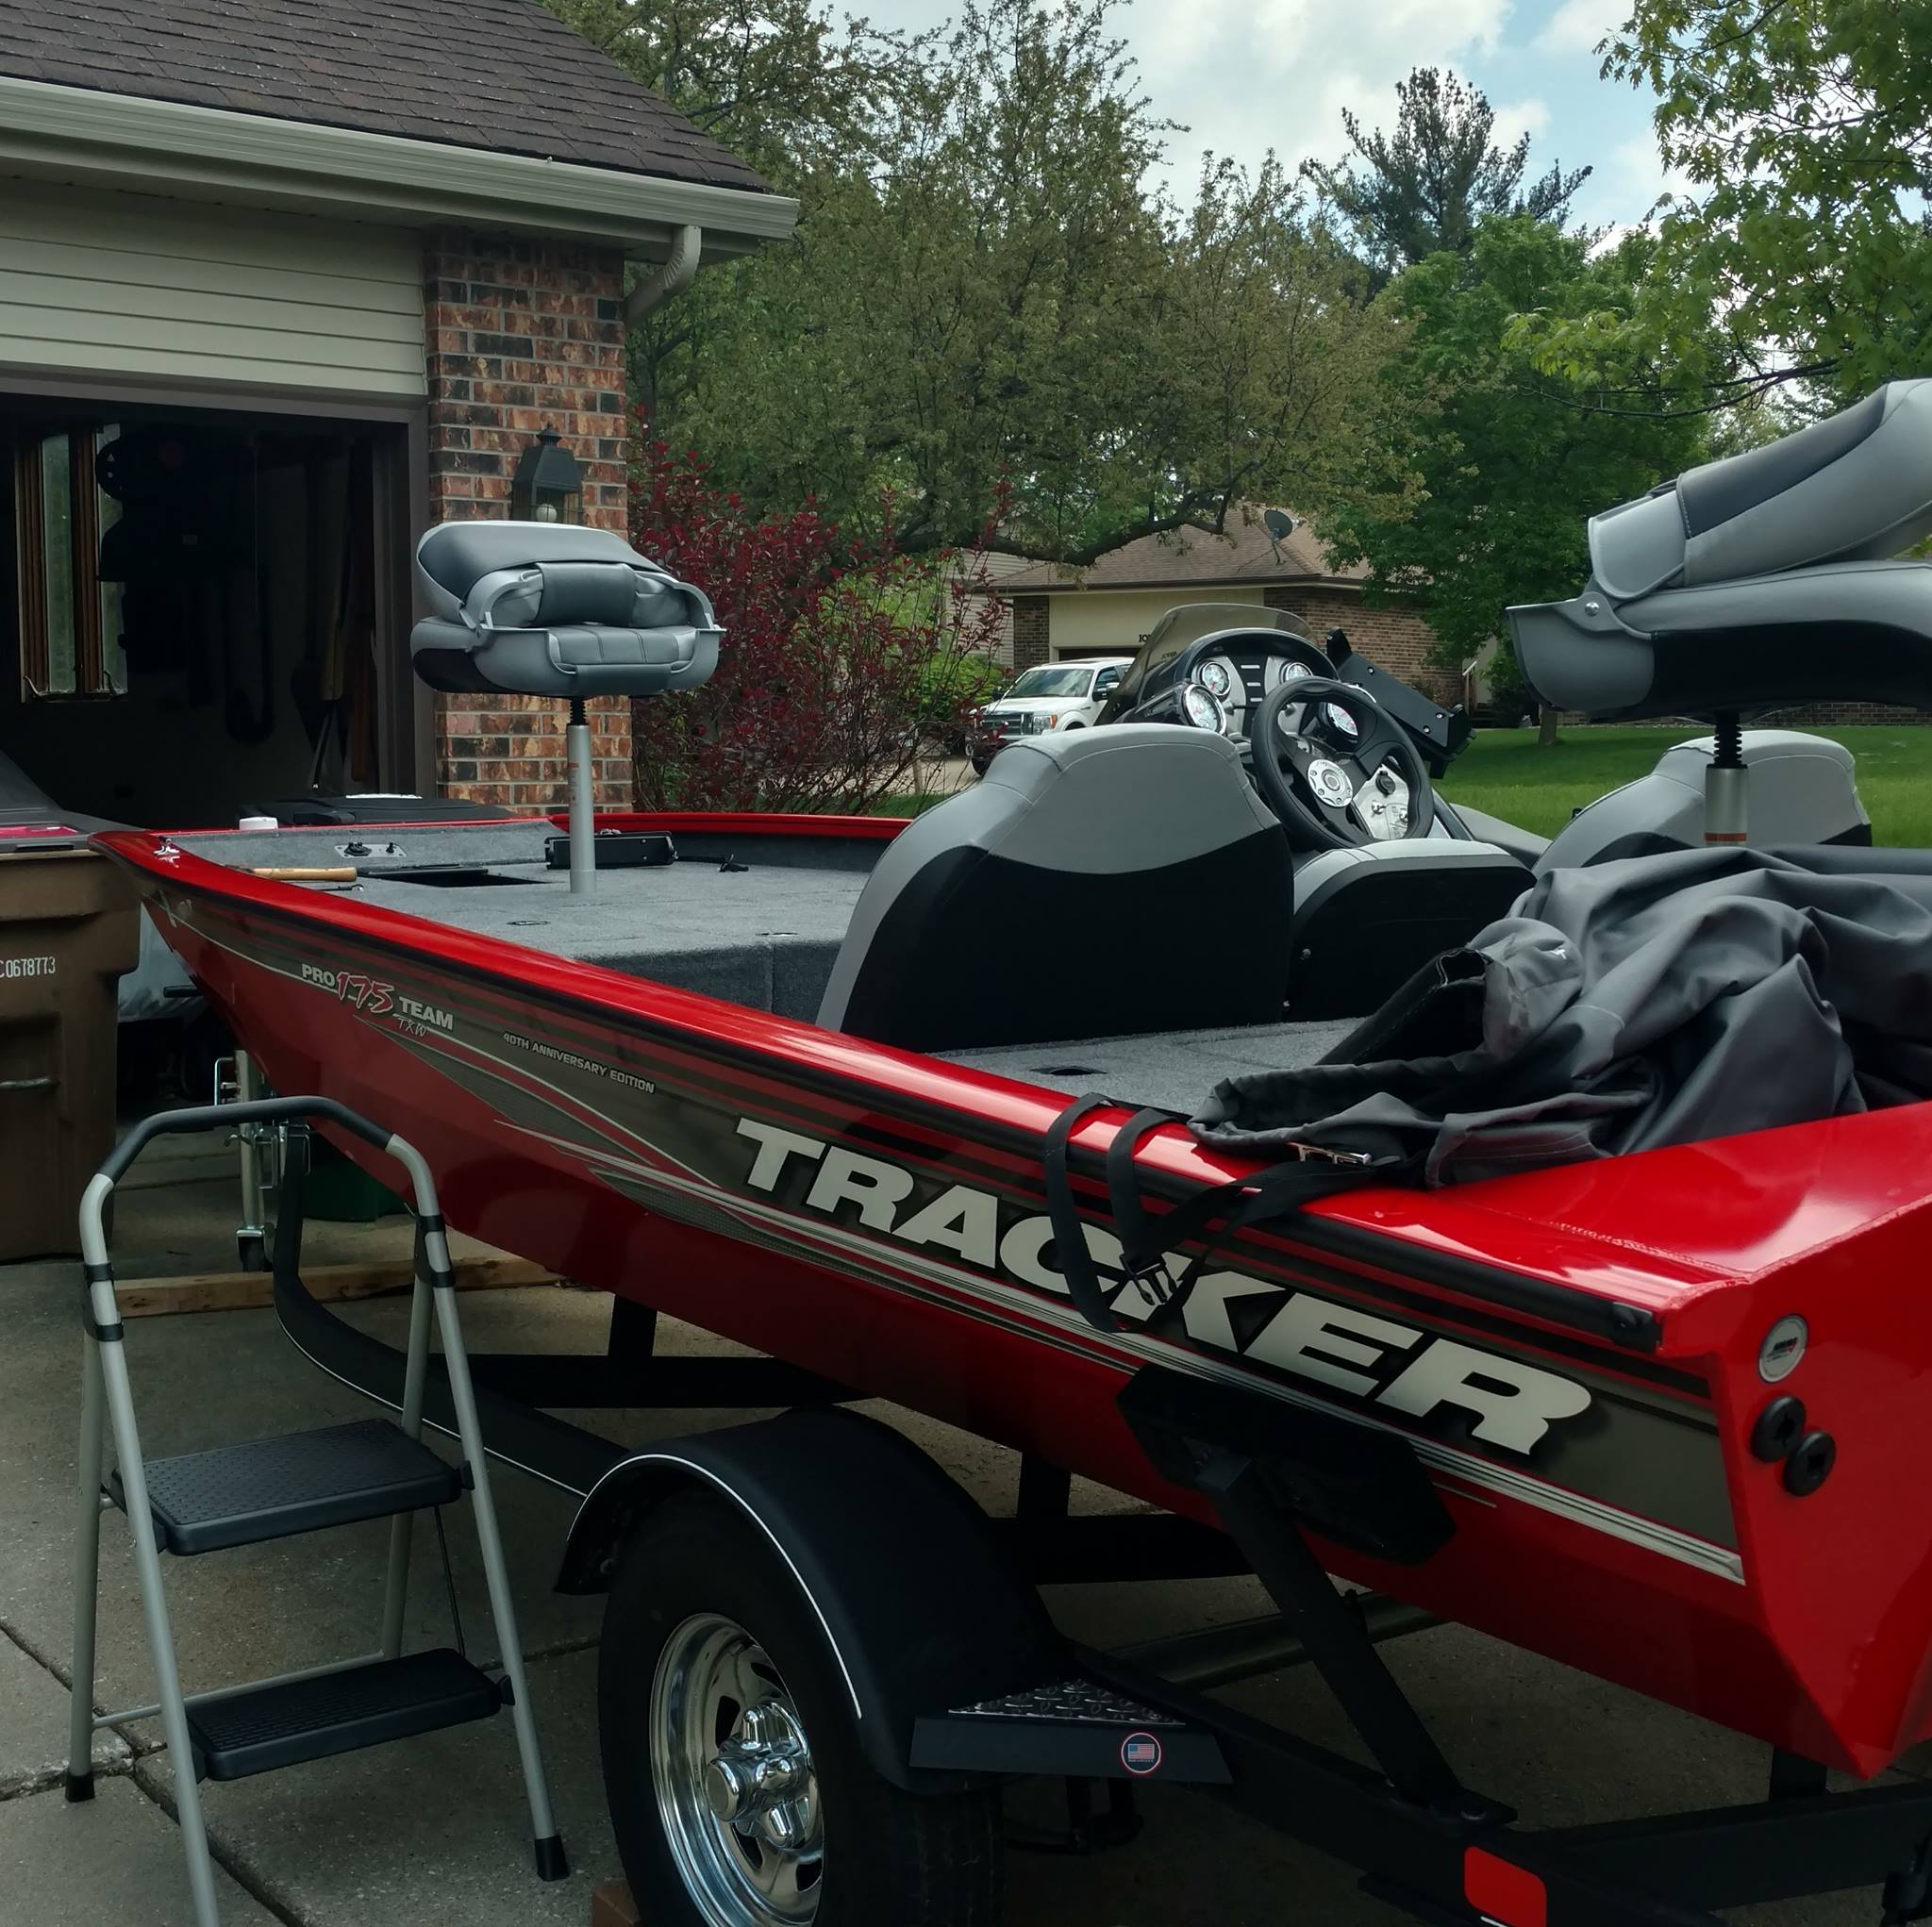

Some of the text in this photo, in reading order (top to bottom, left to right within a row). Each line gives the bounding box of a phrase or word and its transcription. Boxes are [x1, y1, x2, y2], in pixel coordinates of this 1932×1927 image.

[301, 963, 454, 1031] PRO 175 TEAM
[397, 1017, 426, 1038] TXW
[503, 1032, 655, 1094] 40TH ANNIVERSARY EDITION
